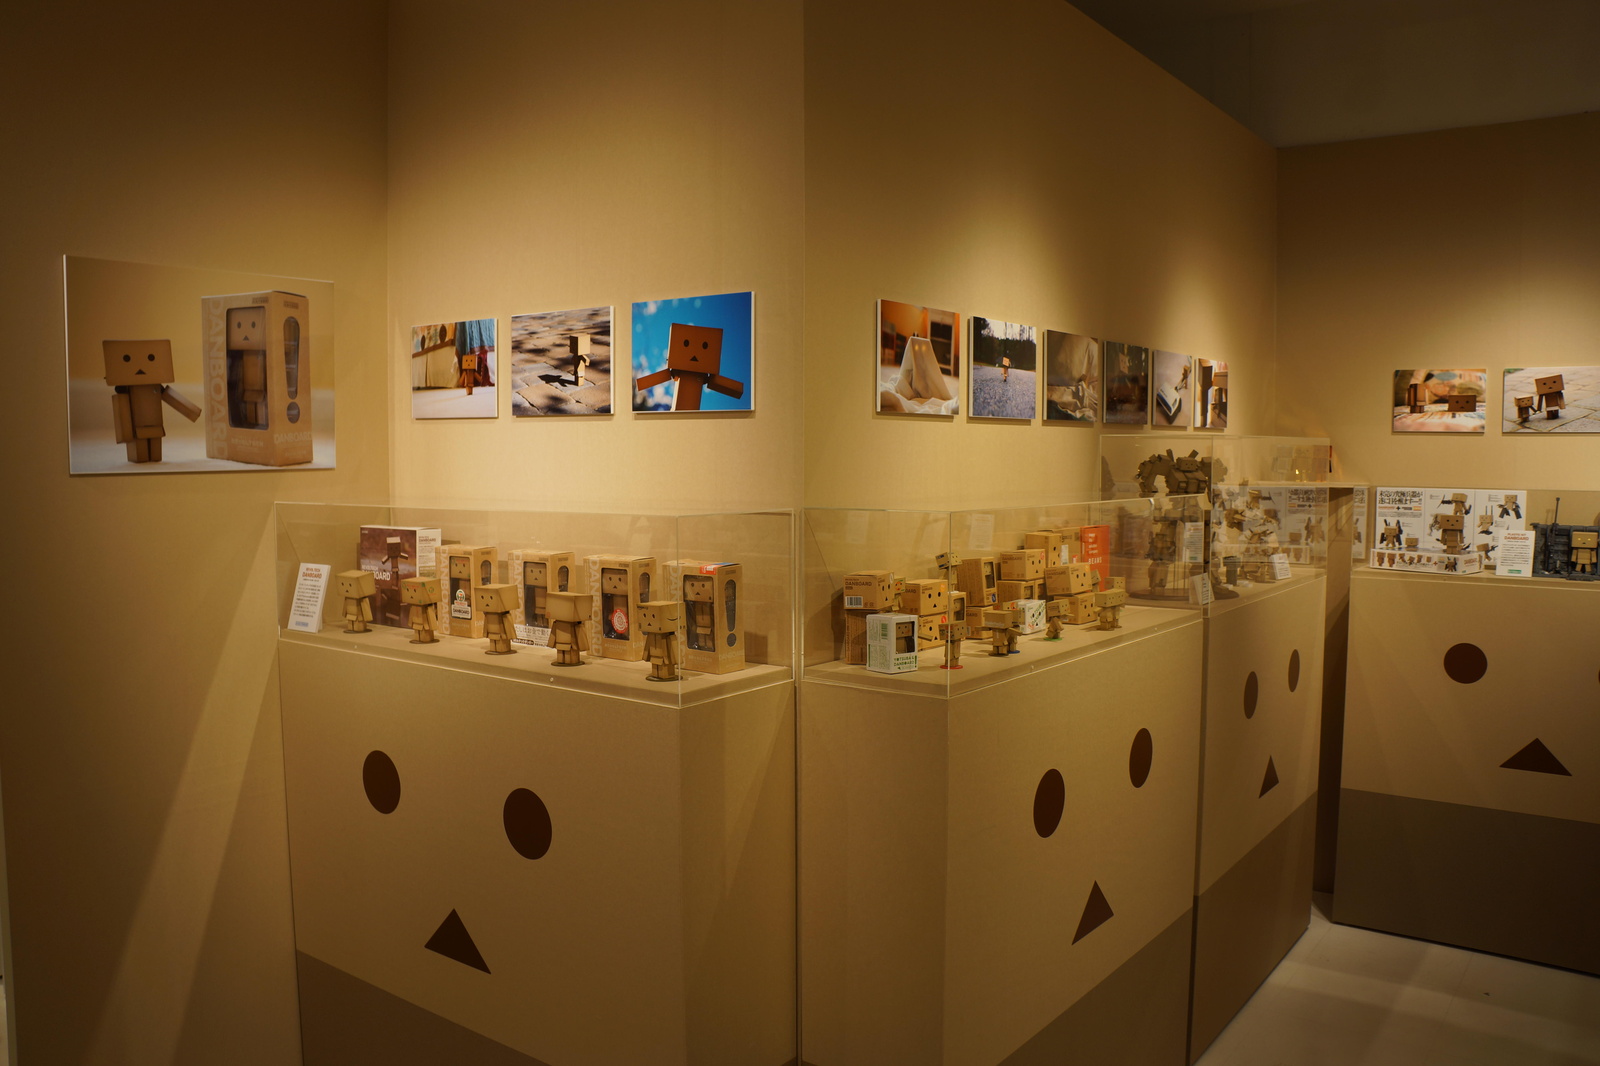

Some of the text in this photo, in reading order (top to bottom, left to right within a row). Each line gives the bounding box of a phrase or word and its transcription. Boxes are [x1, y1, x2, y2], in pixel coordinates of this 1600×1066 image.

[210, 299, 229, 458] DANBOARD
[302, 571, 322, 579] DANBOARD
[440, 546, 451, 635] DANBOARD
[589, 558, 603, 656] DANBOARD
